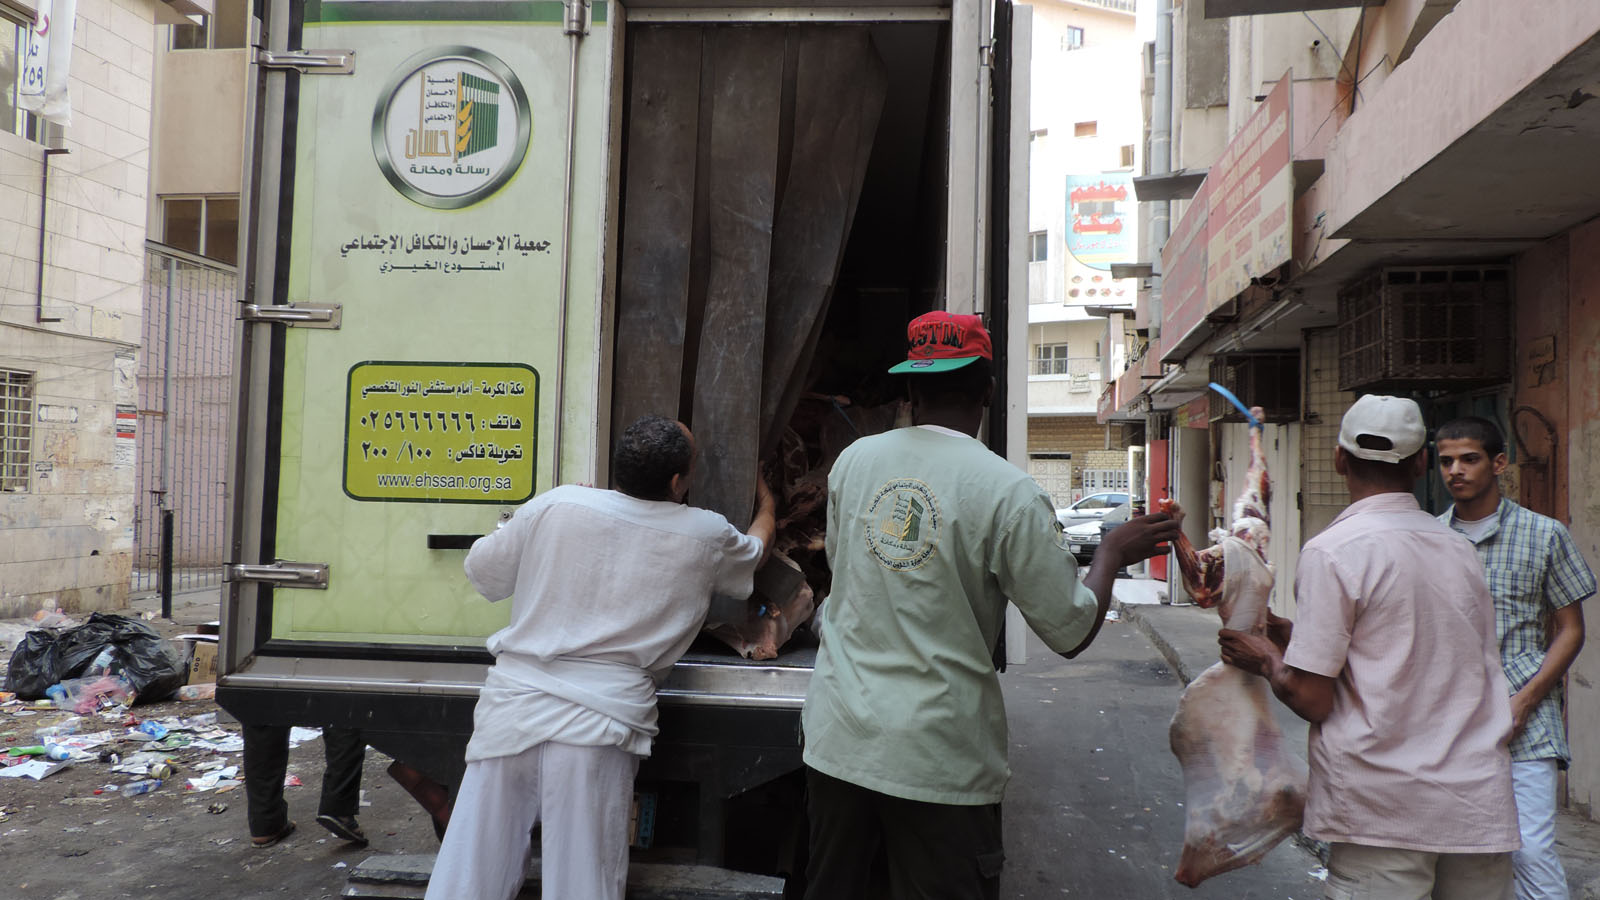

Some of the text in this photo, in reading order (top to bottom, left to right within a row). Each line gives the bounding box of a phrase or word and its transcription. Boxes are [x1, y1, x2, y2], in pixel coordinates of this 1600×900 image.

[410, 164, 490, 176] رسالة ومكانة
[406, 233, 458, 255] والتكافل
[513, 234, 551, 256] جمعية
[379, 260, 442, 274] الخيري
[362, 380, 400, 399] التخصصي
[401, 381, 422, 397] النور
[482, 382, 509, 398] المكرمة
[511, 381, 525, 395] مكة
[488, 443, 523, 464] تحويلة
[377, 473, 512, 493] www.ehssan.org.sa
